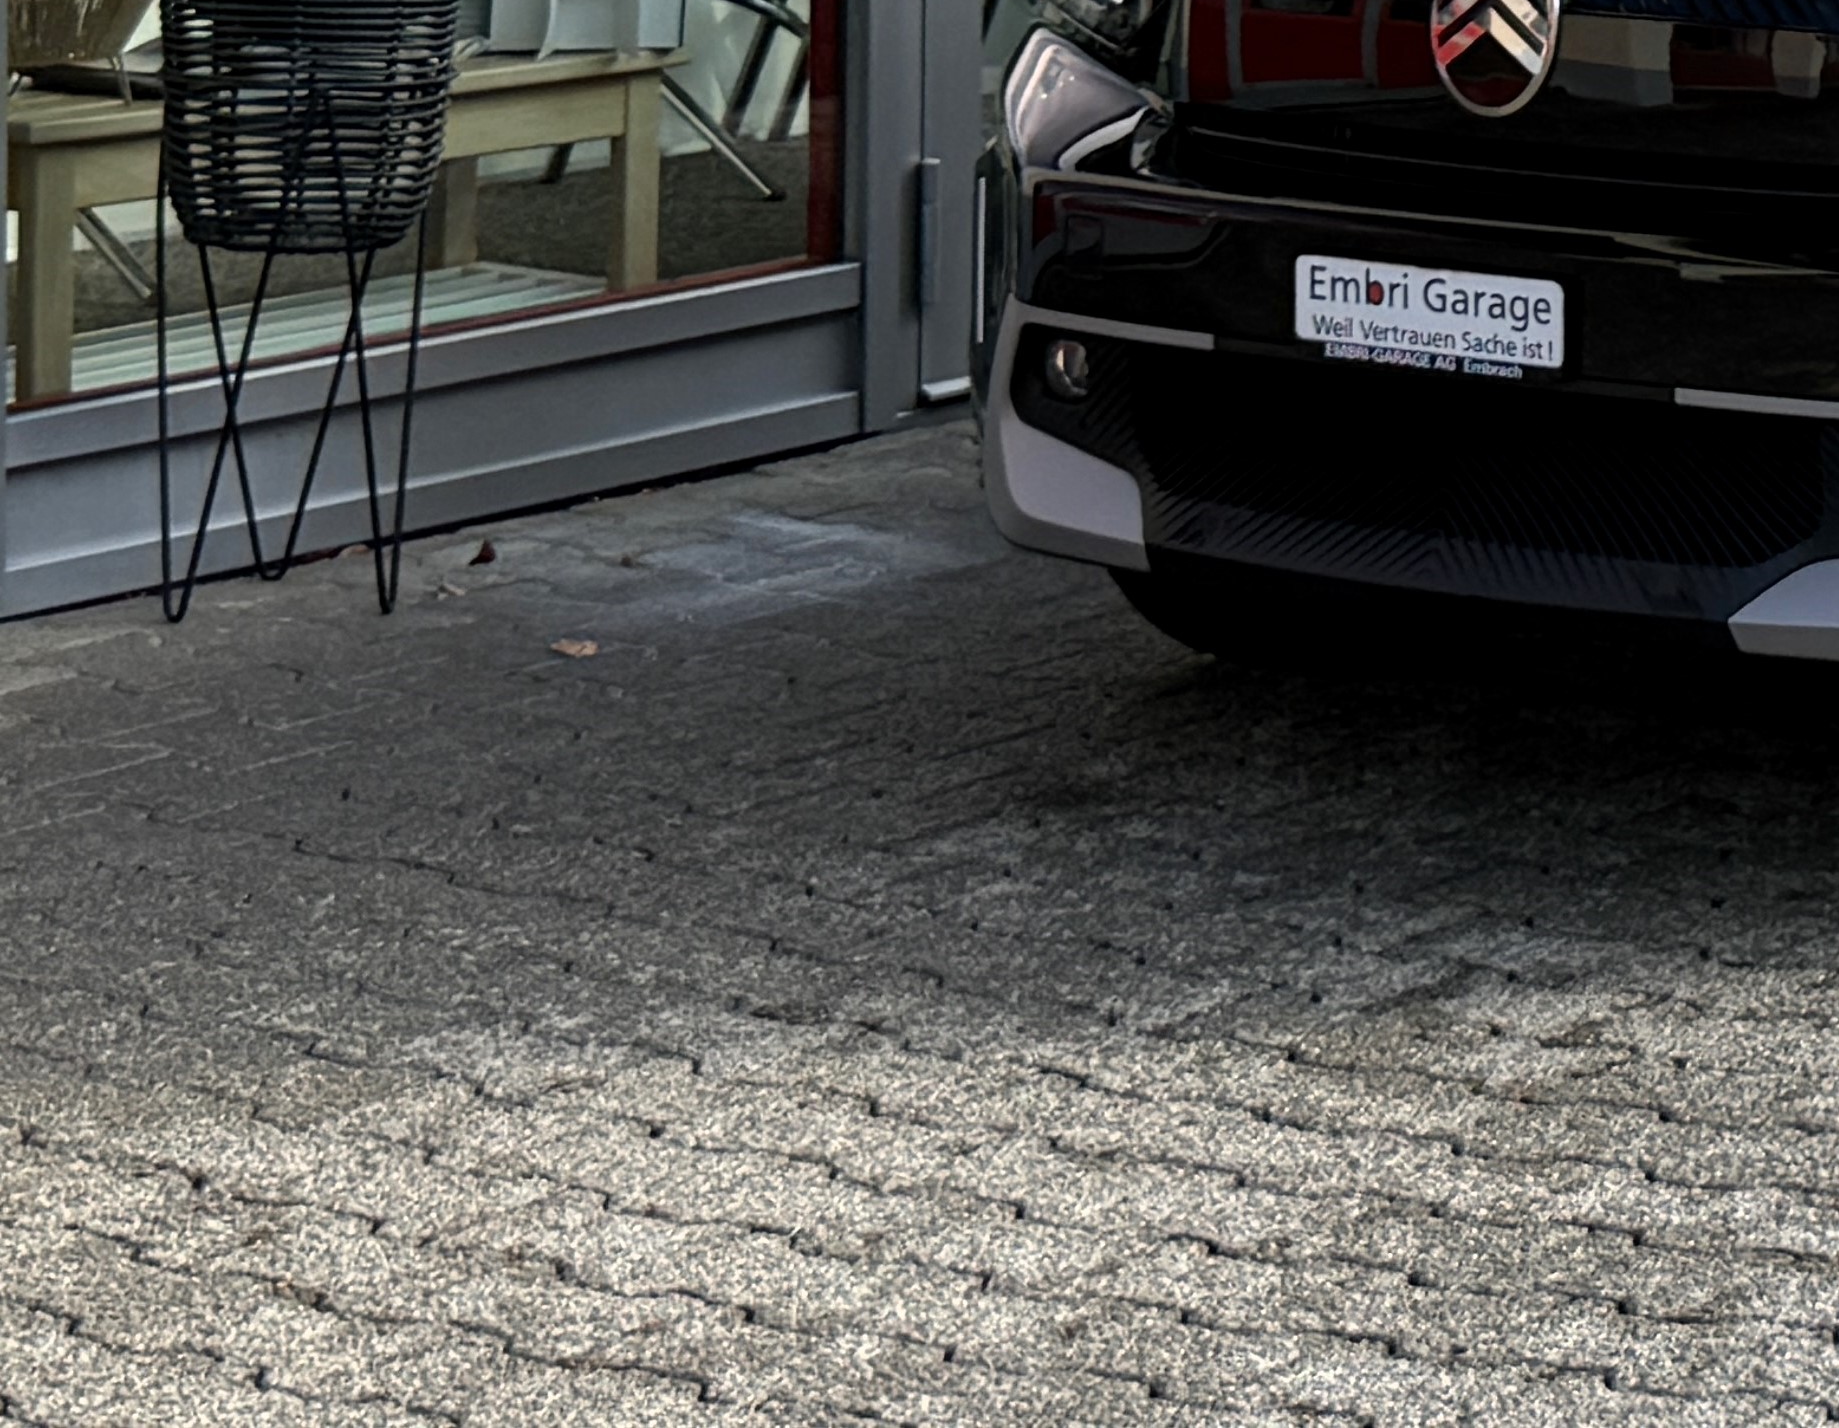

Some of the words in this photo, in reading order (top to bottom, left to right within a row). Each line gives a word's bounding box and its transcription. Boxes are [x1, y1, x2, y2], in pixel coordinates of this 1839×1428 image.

[1309, 264, 1410, 310] Embri
[1422, 277, 1552, 332] Garage
[1312, 313, 1354, 338] Weil
[1359, 319, 1456, 350] Vertrauen
[1462, 330, 1518, 358] Sache
[1433, 354, 1457, 372] AG
[1463, 356, 1523, 380] Embrach
